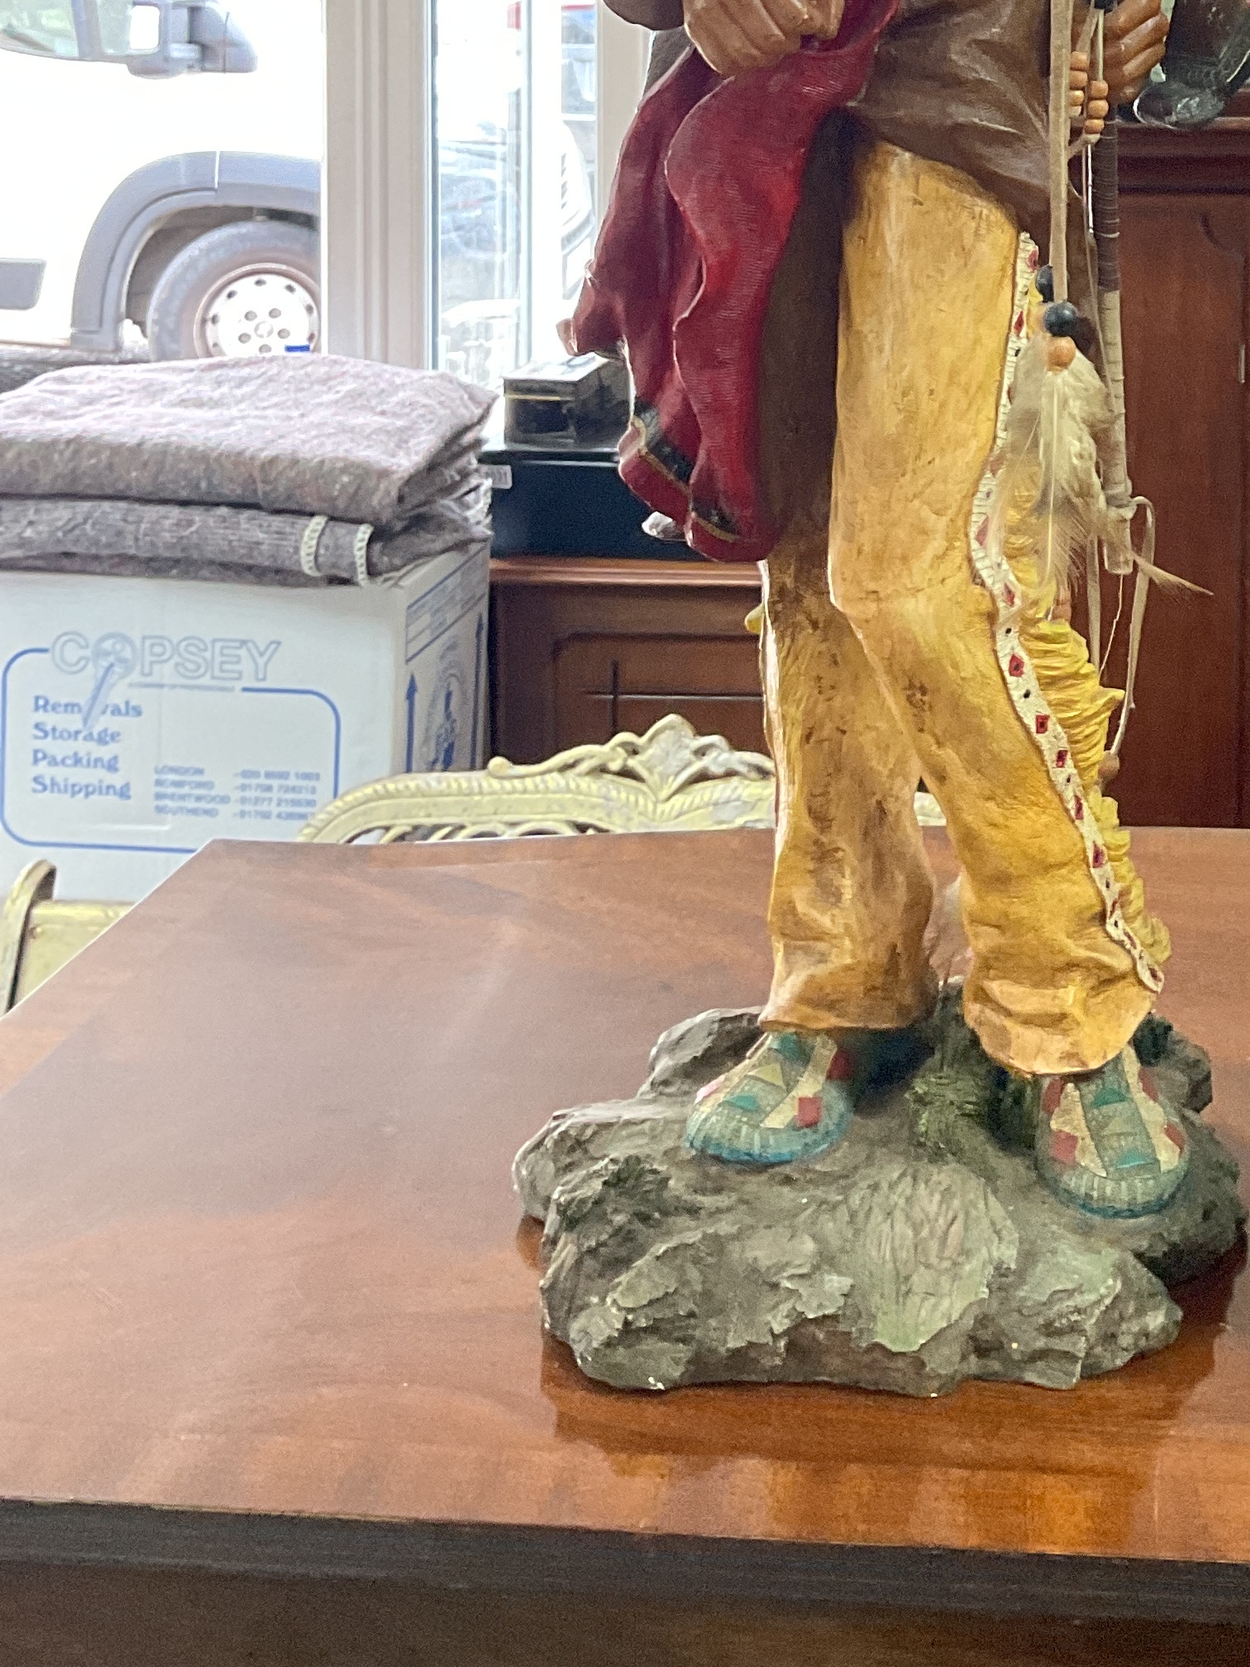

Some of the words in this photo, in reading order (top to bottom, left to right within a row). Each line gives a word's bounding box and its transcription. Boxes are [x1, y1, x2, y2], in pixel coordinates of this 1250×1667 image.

[51, 631, 281, 682] COPSEY
[33, 694, 142, 717] Remvals
[32, 722, 121, 746] Storage
[32, 748, 119, 773] Packing
[32, 774, 131, 800] Shipping
